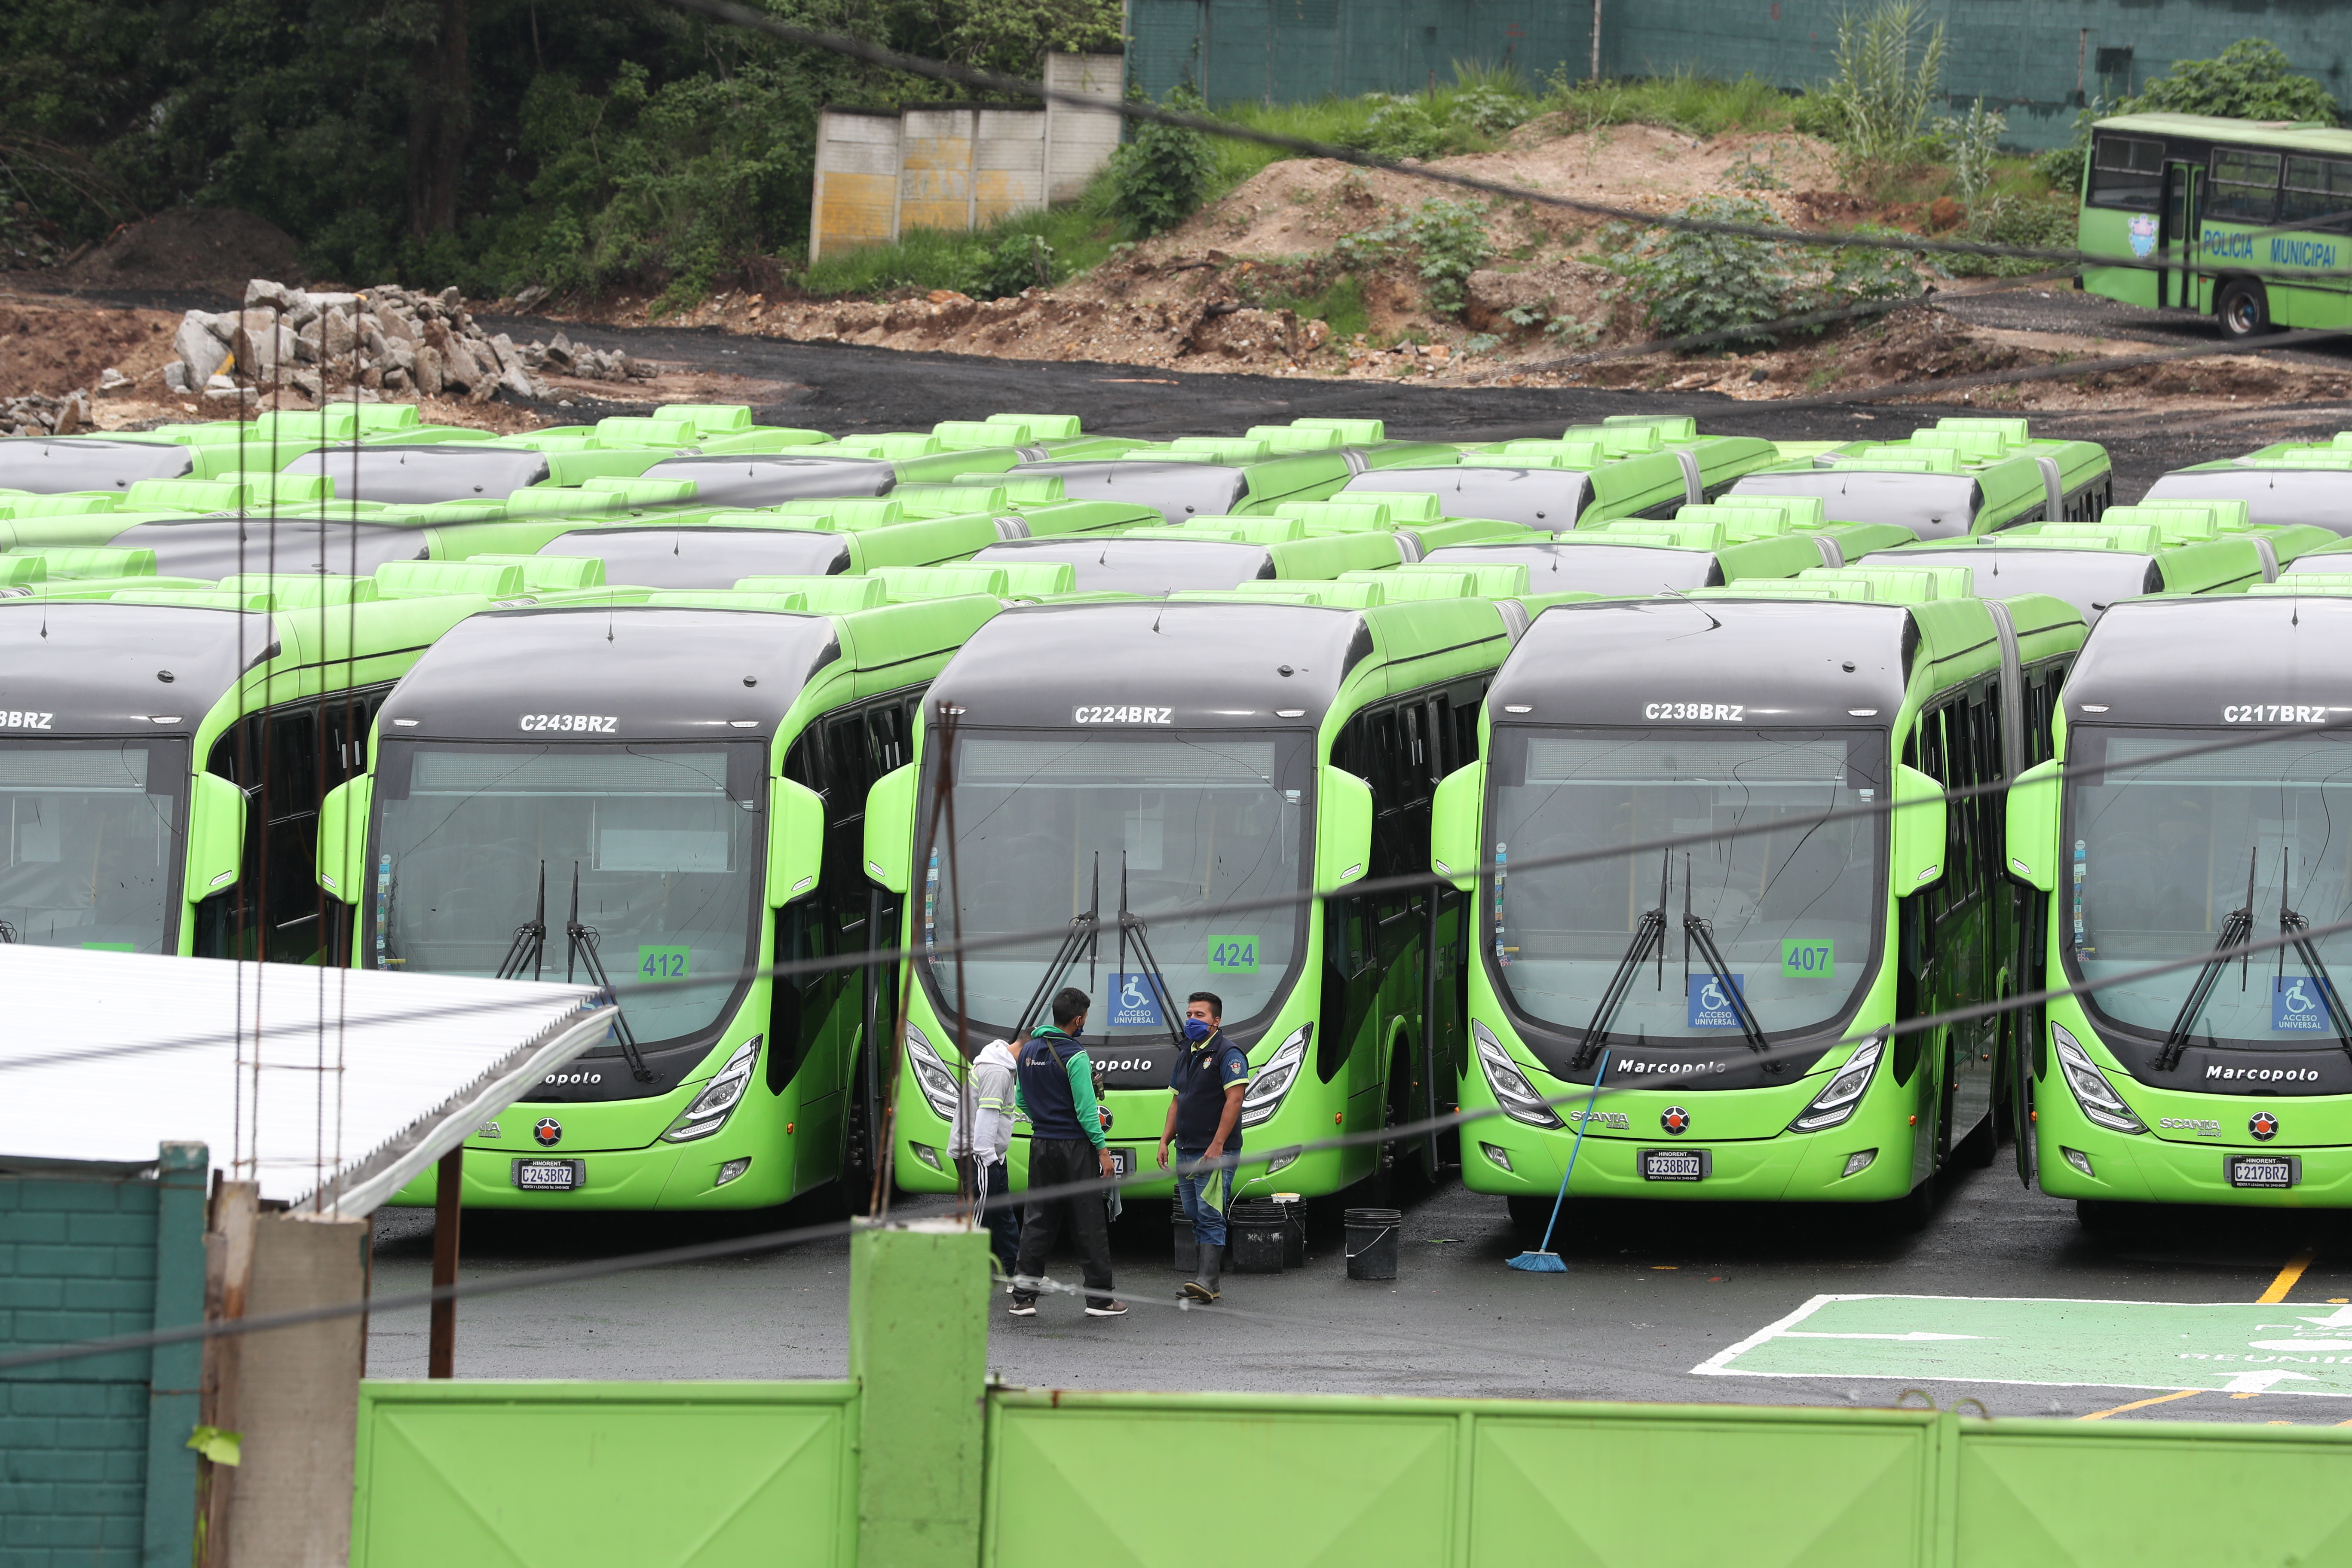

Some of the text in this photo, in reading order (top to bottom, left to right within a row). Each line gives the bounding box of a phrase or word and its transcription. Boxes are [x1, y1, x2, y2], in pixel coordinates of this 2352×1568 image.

[2203, 230, 2253, 260] POLICIA
[1075, 706, 1172, 724] C224BRZ
[1646, 703, 1743, 721] C238BRZ
[2224, 705, 2325, 723] C217BRZ
[521, 715, 617, 733] C243BRZ
[1213, 943, 1254, 967] 424
[1788, 947, 1829, 971] 407
[643, 953, 684, 977] 412
[1617, 1060, 1726, 1075] Marcopolo
[2205, 1066, 2319, 1081] Marcopolo
[538, 1072, 601, 1087] opolo
[2159, 1118, 2221, 1130] SCANIA
